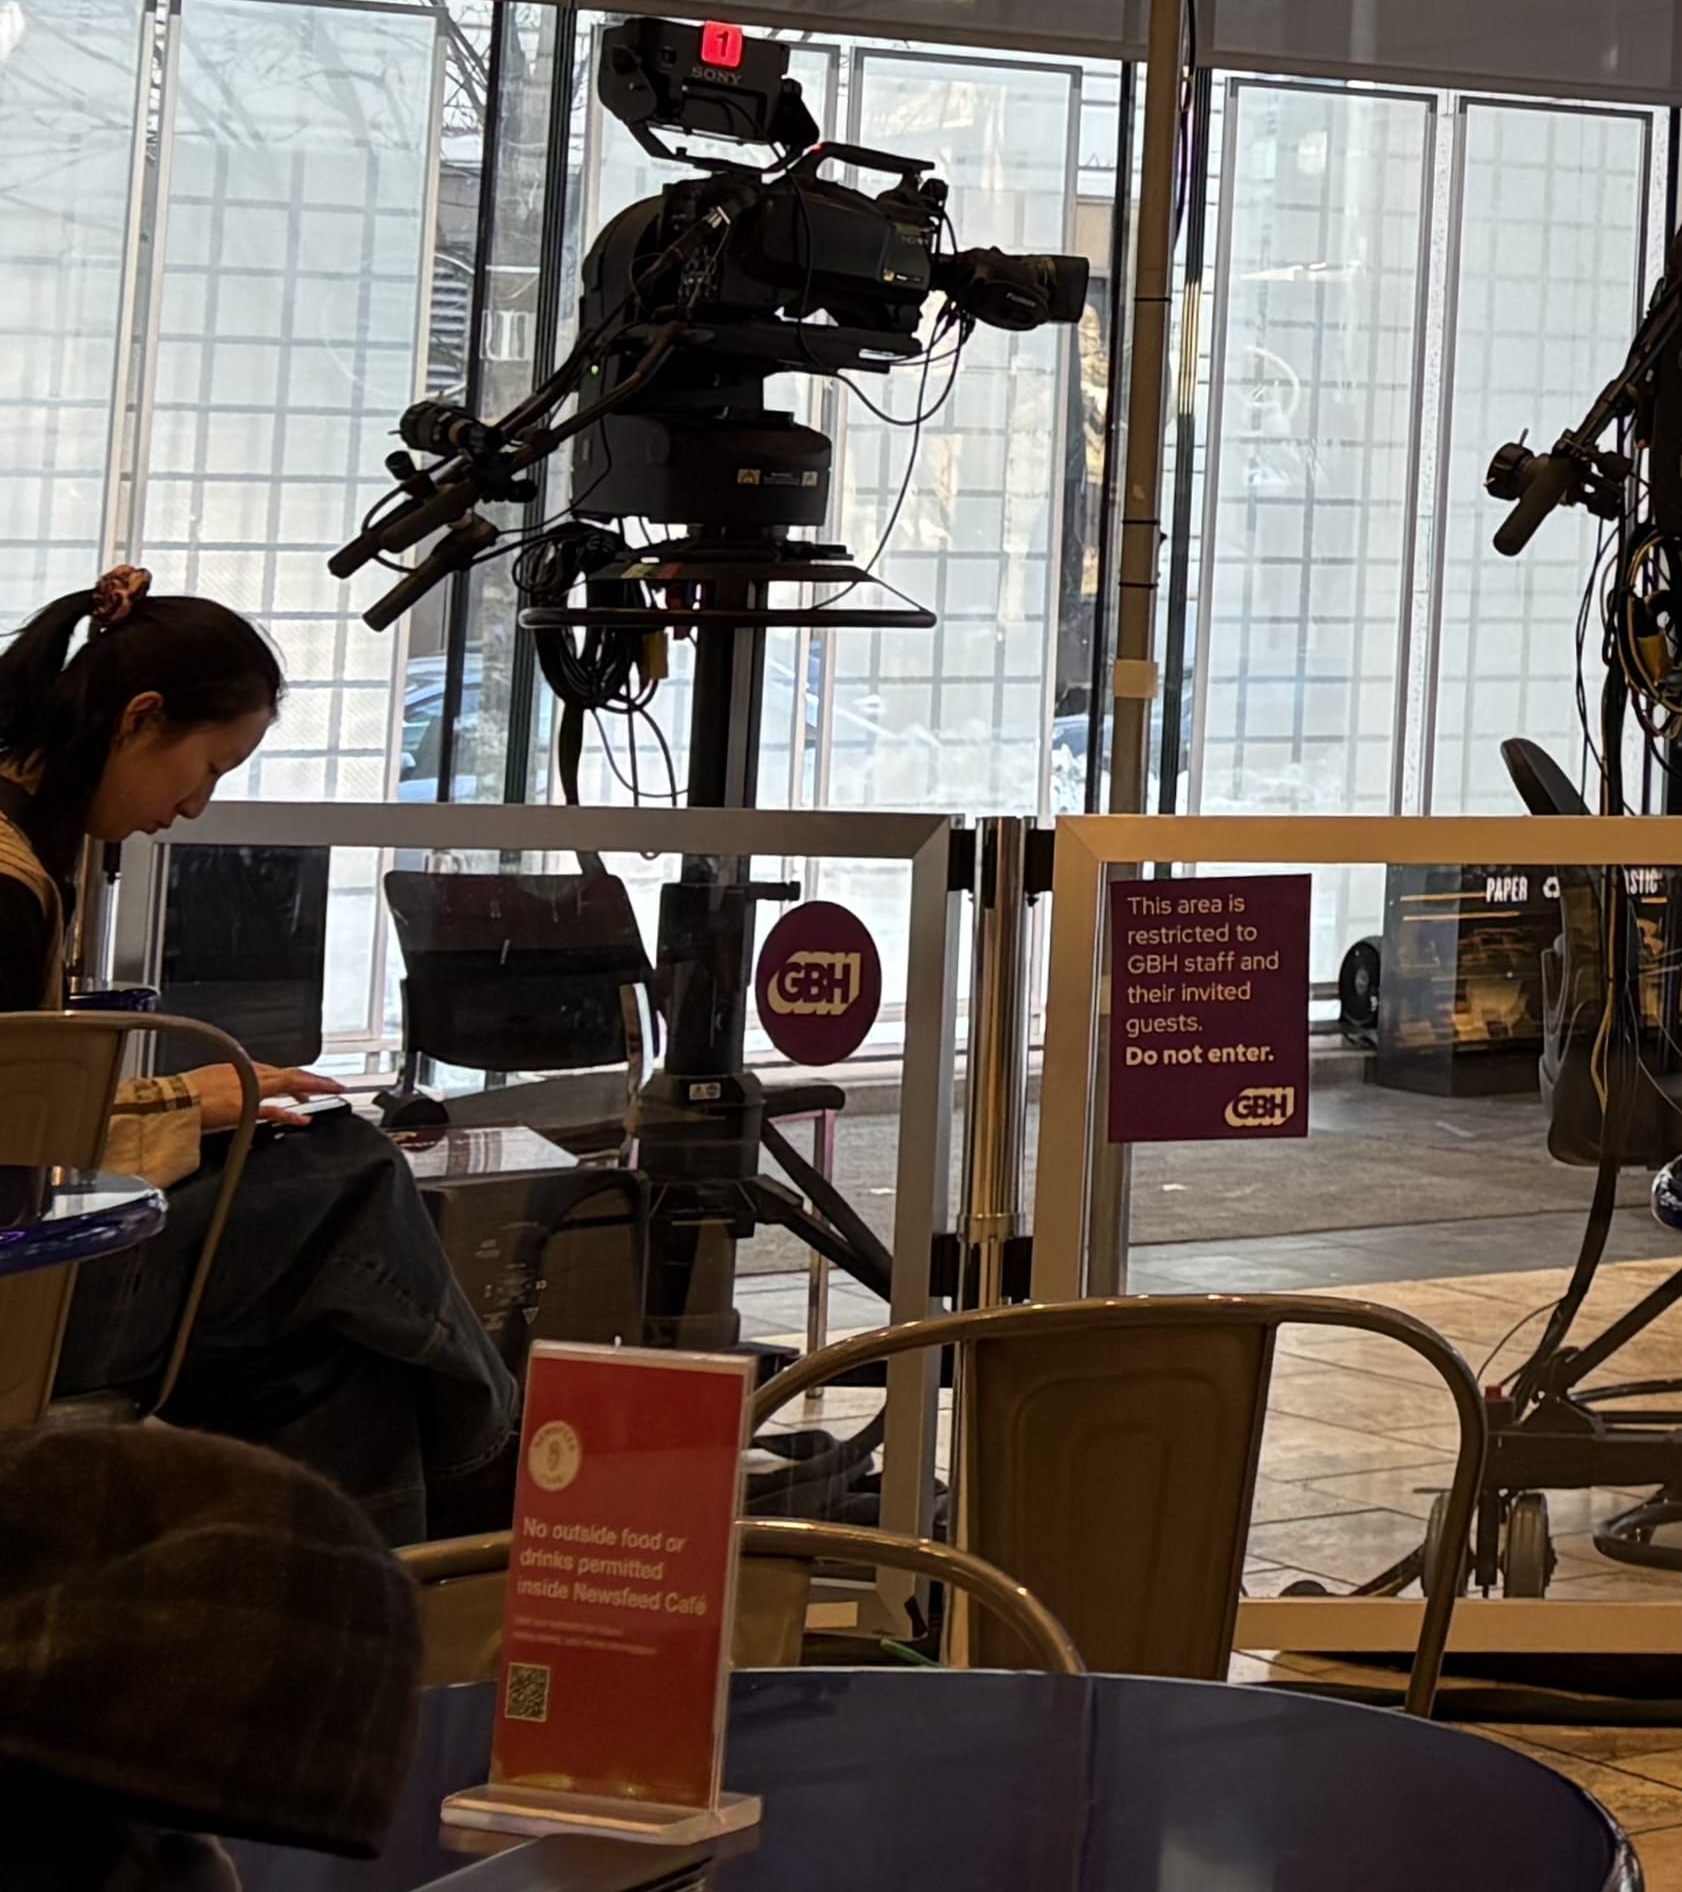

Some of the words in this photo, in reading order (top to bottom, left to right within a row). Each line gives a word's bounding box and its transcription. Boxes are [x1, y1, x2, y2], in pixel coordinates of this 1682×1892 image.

[716, 30, 729, 58] 1
[691, 66, 742, 85] SONY
[1486, 876, 1528, 902] PAPER
[1127, 896, 1172, 915] This
[1177, 898, 1222, 914] area
[1229, 894, 1246, 912] is
[1127, 922, 1229, 945] restricted
[1236, 924, 1258, 942] to
[1127, 954, 1178, 974] GBH
[1184, 951, 1235, 973] staff
[1240, 951, 1279, 971] and
[767, 951, 862, 1016] GBH
[1127, 983, 1175, 1004] their
[1181, 981, 1251, 1001] invited
[1126, 1015, 1203, 1038] guests.
[1126, 1046, 1158, 1066] Do
[1163, 1045, 1203, 1065] not
[1207, 1043, 1275, 1063] enter.
[1224, 1086, 1295, 1127] GBH
[523, 1517, 547, 1538] No
[552, 1524, 617, 1546] outside
[621, 1528, 662, 1550] food
[665, 1537, 686, 1553] or
[519, 1548, 574, 1571] drinks
[577, 1557, 664, 1581] permitted
[516, 1575, 569, 1599] inside
[573, 1582, 660, 1610] Newsfeed
